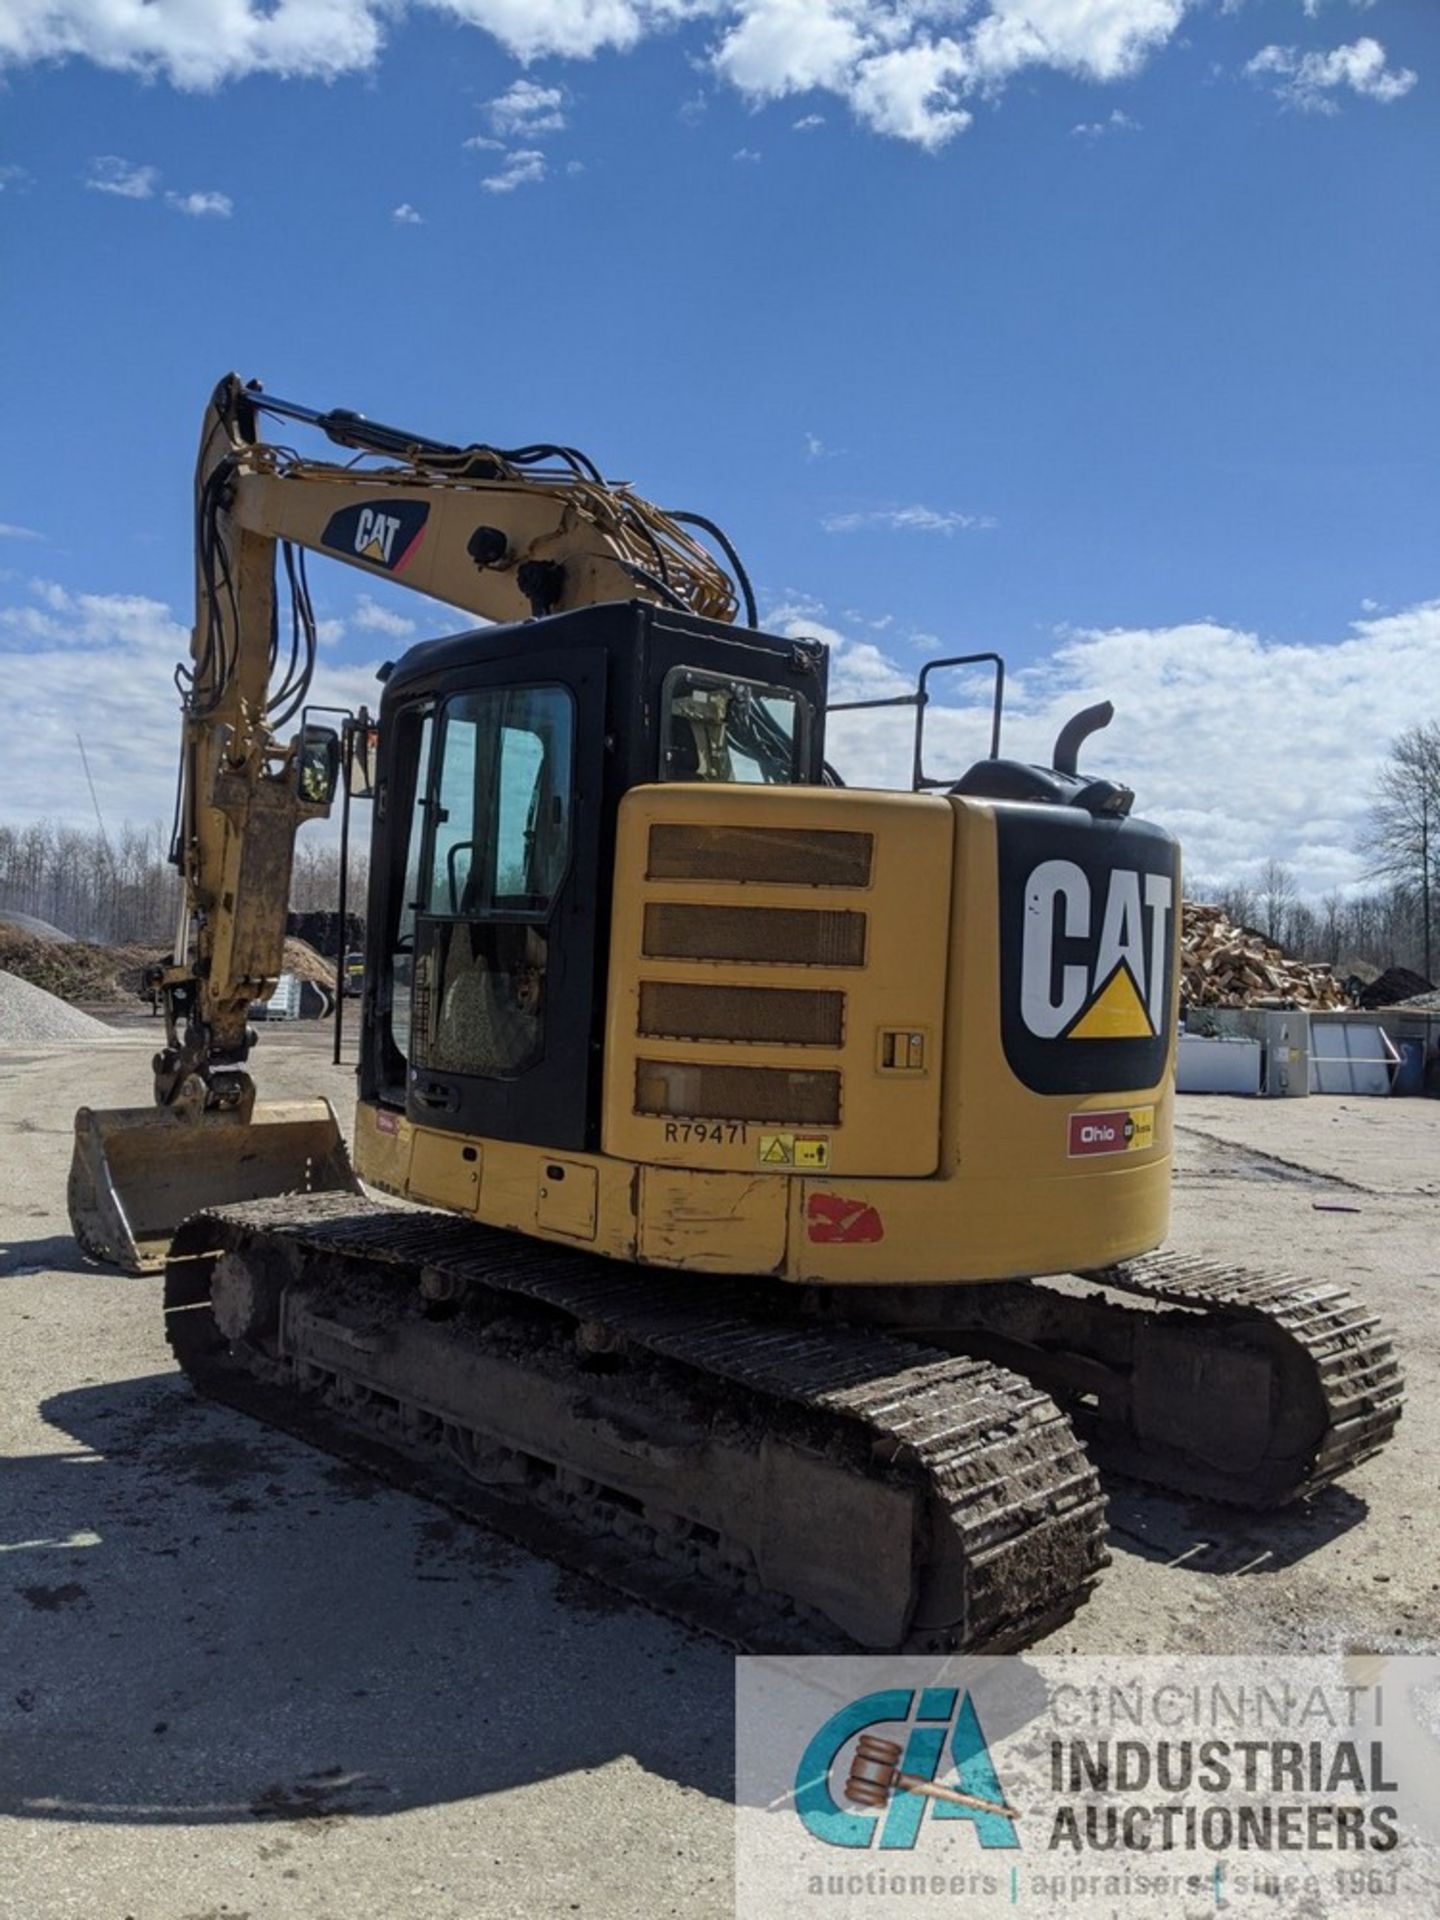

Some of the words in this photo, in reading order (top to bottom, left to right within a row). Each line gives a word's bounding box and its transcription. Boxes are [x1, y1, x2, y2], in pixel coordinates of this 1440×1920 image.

[354, 508, 401, 563] CAT
[1020, 859, 1172, 1039] CAT
[665, 1123, 747, 1144] R79471
[1081, 1125, 1115, 1143] Ohio
